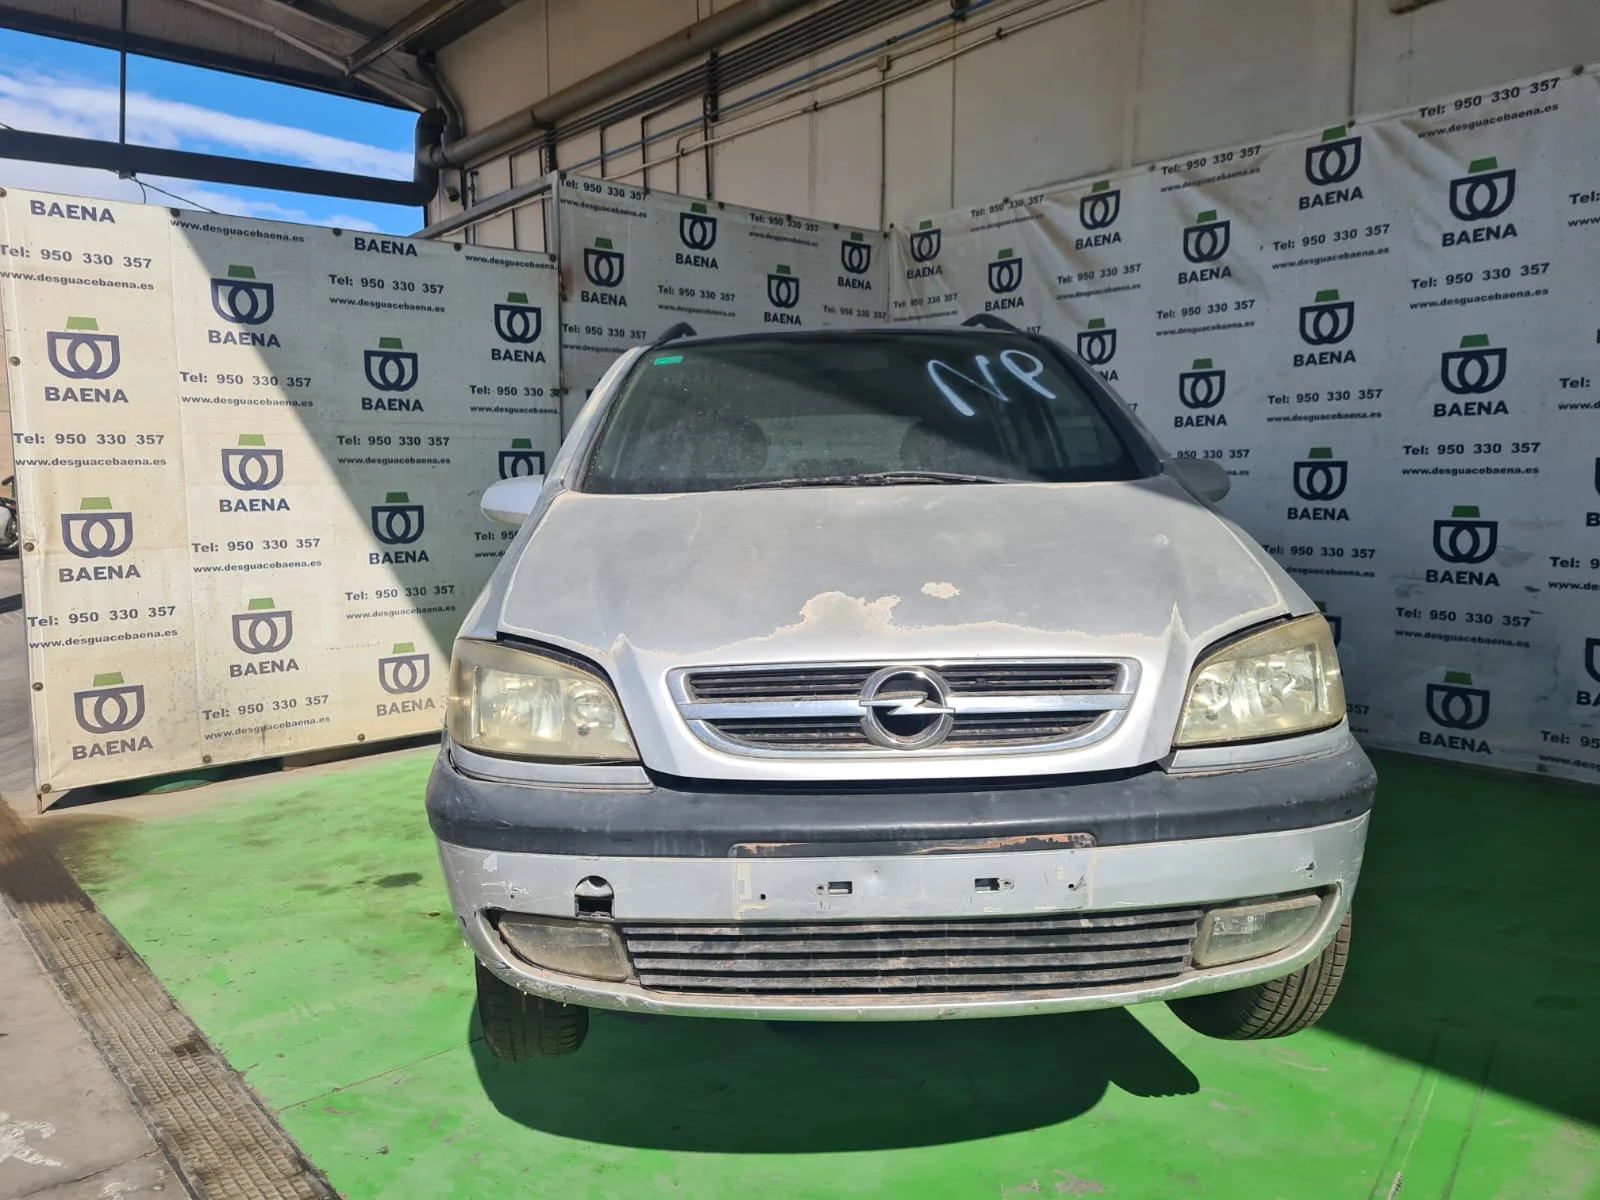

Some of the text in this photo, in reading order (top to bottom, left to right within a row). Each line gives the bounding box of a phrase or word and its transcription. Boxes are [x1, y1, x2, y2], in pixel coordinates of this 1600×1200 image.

[1419, 77, 1560, 118] Tel: 950 330 357
[1418, 102, 1558, 138] www.desguacebaena.es
[1161, 145, 1262, 175] Tel: 950 330 357
[584, 182, 602, 193] 950
[608, 187, 625, 198] 330
[631, 190, 648, 200] 357
[1299, 186, 1363, 210] BAENA
[1569, 191, 1600, 204] Tel:
[30, 200, 115, 223] BAENA
[170, 218, 304, 242] www.desguacebaena.es
[1273, 224, 1390, 251] Tel: 950 330 357
[1442, 223, 1517, 247] BAENA
[355, 237, 419, 257] BAENA
[1076, 232, 1121, 250] BAENA
[0, 244, 152, 268] Tel: 950 330 357
[676, 253, 718, 269] BAENA
[1272, 247, 1389, 270] www.desguacebaena.es
[907, 265, 943, 279] BAENA
[1057, 263, 1141, 284] Tel: 950 330 357
[1179, 266, 1231, 284] BAENA
[1411, 262, 1550, 289] Tel: 950 330 357
[0, 272, 154, 291] www.desguacebaena.es
[329, 274, 444, 294] Tel: 950 330 357
[838, 276, 871, 290] BAENA
[581, 291, 627, 307] BAENA
[658, 285, 735, 302] Tel: 950 330 357
[1410, 289, 1548, 309] www.desguacebaena.es
[330, 298, 445, 312] www.desguacebaena.es
[985, 297, 1024, 312] BAENA
[1157, 299, 1255, 319] Tel: 950 330 357
[764, 312, 801, 325] BAENA
[208, 330, 280, 347] BAENA
[562, 324, 646, 340] Tel: 950 330 357
[492, 348, 546, 363] BAENA
[1294, 350, 1356, 367] BAENA
[179, 371, 311, 387] Tel: 950 330 357
[1560, 377, 1590, 388] Tel:
[45, 387, 128, 403] BAENA
[470, 385, 490, 395] Tel:
[497, 386, 517, 396] 950
[524, 387, 543, 397] 330
[1268, 389, 1383, 404] Tel: 950 330 357
[181, 396, 313, 406] www.desguacebaena.es
[362, 398, 424, 412] BAENA
[1434, 400, 1509, 417] BAENA
[1175, 414, 1227, 427] BAENA
[1267, 412, 1382, 422] www.desguacebaena.es
[12, 433, 164, 444] Tel: 950 330 357
[337, 435, 449, 446] Tel: 950 330 357
[1178, 449, 1250, 459] 950 330 357
[1403, 442, 1540, 455] Tel: 950 330 357
[16, 458, 166, 468] www.desguacebaena.es
[338, 457, 450, 465] www.desguacebaena.es
[1402, 466, 1539, 476] www.desguacebaena.es
[219, 498, 290, 512] BAENA
[1288, 507, 1349, 521] BAENA
[474, 532, 495, 540] Tel:
[191, 539, 320, 552] Tel: 950 330 357
[1262, 545, 1376, 558] Tel: 950 330 357
[369, 550, 429, 565] BAENA
[1550, 557, 1580, 568] Tel:
[59, 565, 141, 582] BAENA
[193, 561, 321, 573] www.desguacebaena.es
[1426, 570, 1500, 587] BAENA
[344, 585, 454, 600] Tel: 950 330 357
[27, 606, 175, 627] Tel: 950 330 357
[346, 606, 455, 619] www.desguacebaena.es
[1396, 607, 1531, 627] Tel: 950 330 357
[29, 630, 177, 648] www.desguacebaena.es
[1395, 630, 1530, 648] www.desguacebaena.es
[230, 658, 299, 678] BAENA
[202, 695, 328, 720] Tel: 950 330 357
[377, 698, 435, 716] BAENA
[202, 716, 330, 741] www.desguacebaena.es
[1419, 731, 1492, 754] BAENA
[1540, 731, 1570, 744] Tel:
[72, 736, 153, 760] BAENA
